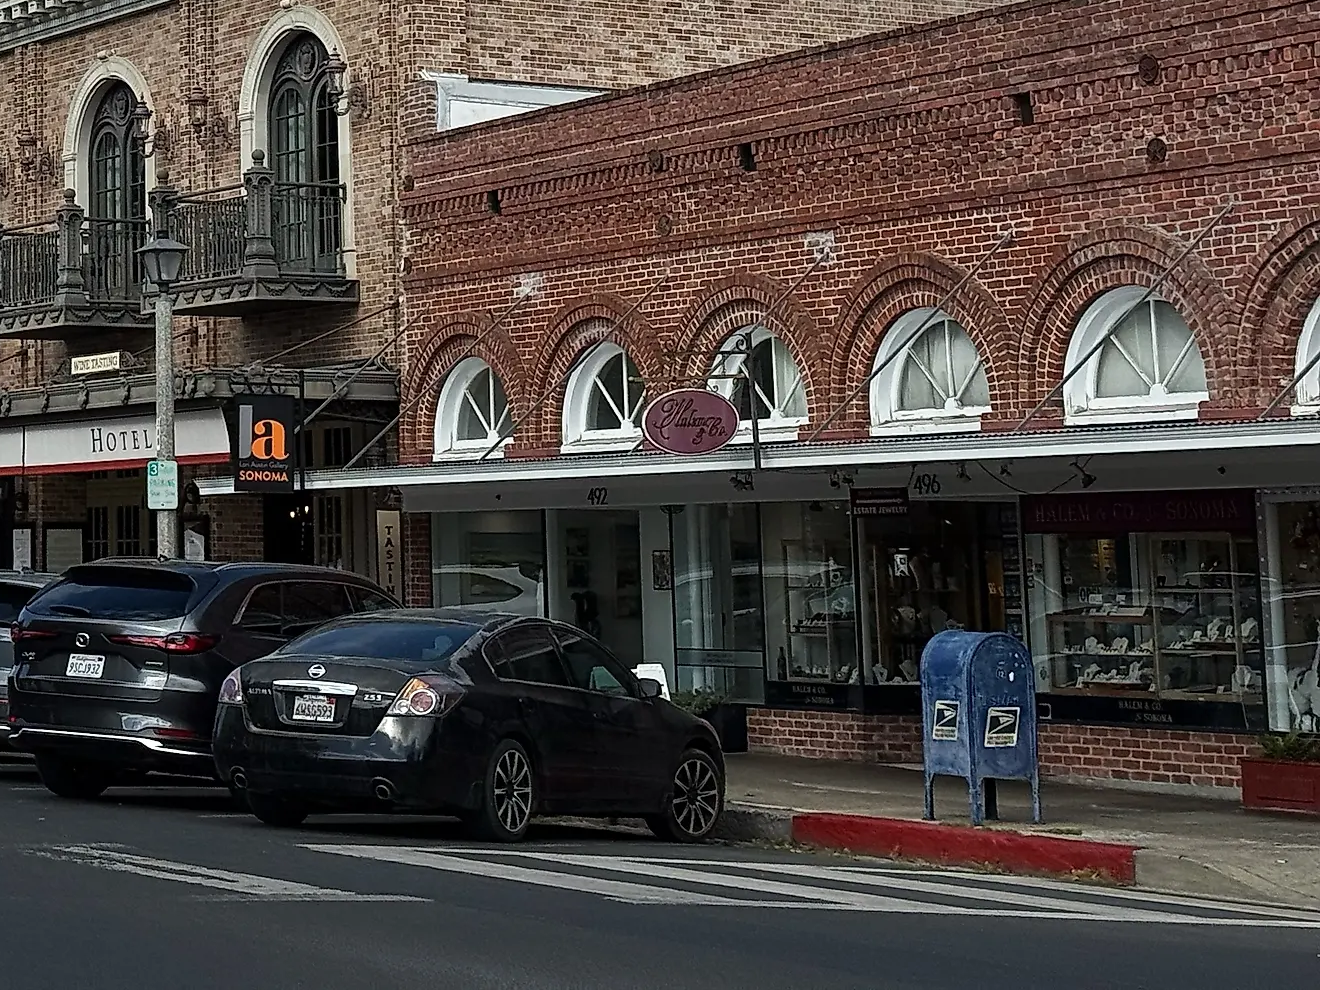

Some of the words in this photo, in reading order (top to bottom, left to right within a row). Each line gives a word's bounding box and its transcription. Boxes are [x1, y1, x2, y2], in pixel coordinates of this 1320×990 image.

[74, 359, 90, 373] WINE
[91, 355, 118, 371] TASTING
[91, 427, 153, 452] HOTEL
[150, 464, 158, 476] 3
[269, 461, 289, 470] Gallery
[239, 470, 289, 482] SONOMA
[913, 473, 941, 494] 496
[587, 487, 609, 505] 492
[853, 506, 877, 515] ESTATE
[878, 506, 908, 514] JEWELRY
[1035, 501, 1091, 522] HALEM
[1165, 497, 1239, 521] SONOMA
[384, 525, 396, 596] TASTIN
[1118, 700, 1143, 710] HALEM
[1143, 713, 1173, 723] SONOMA
